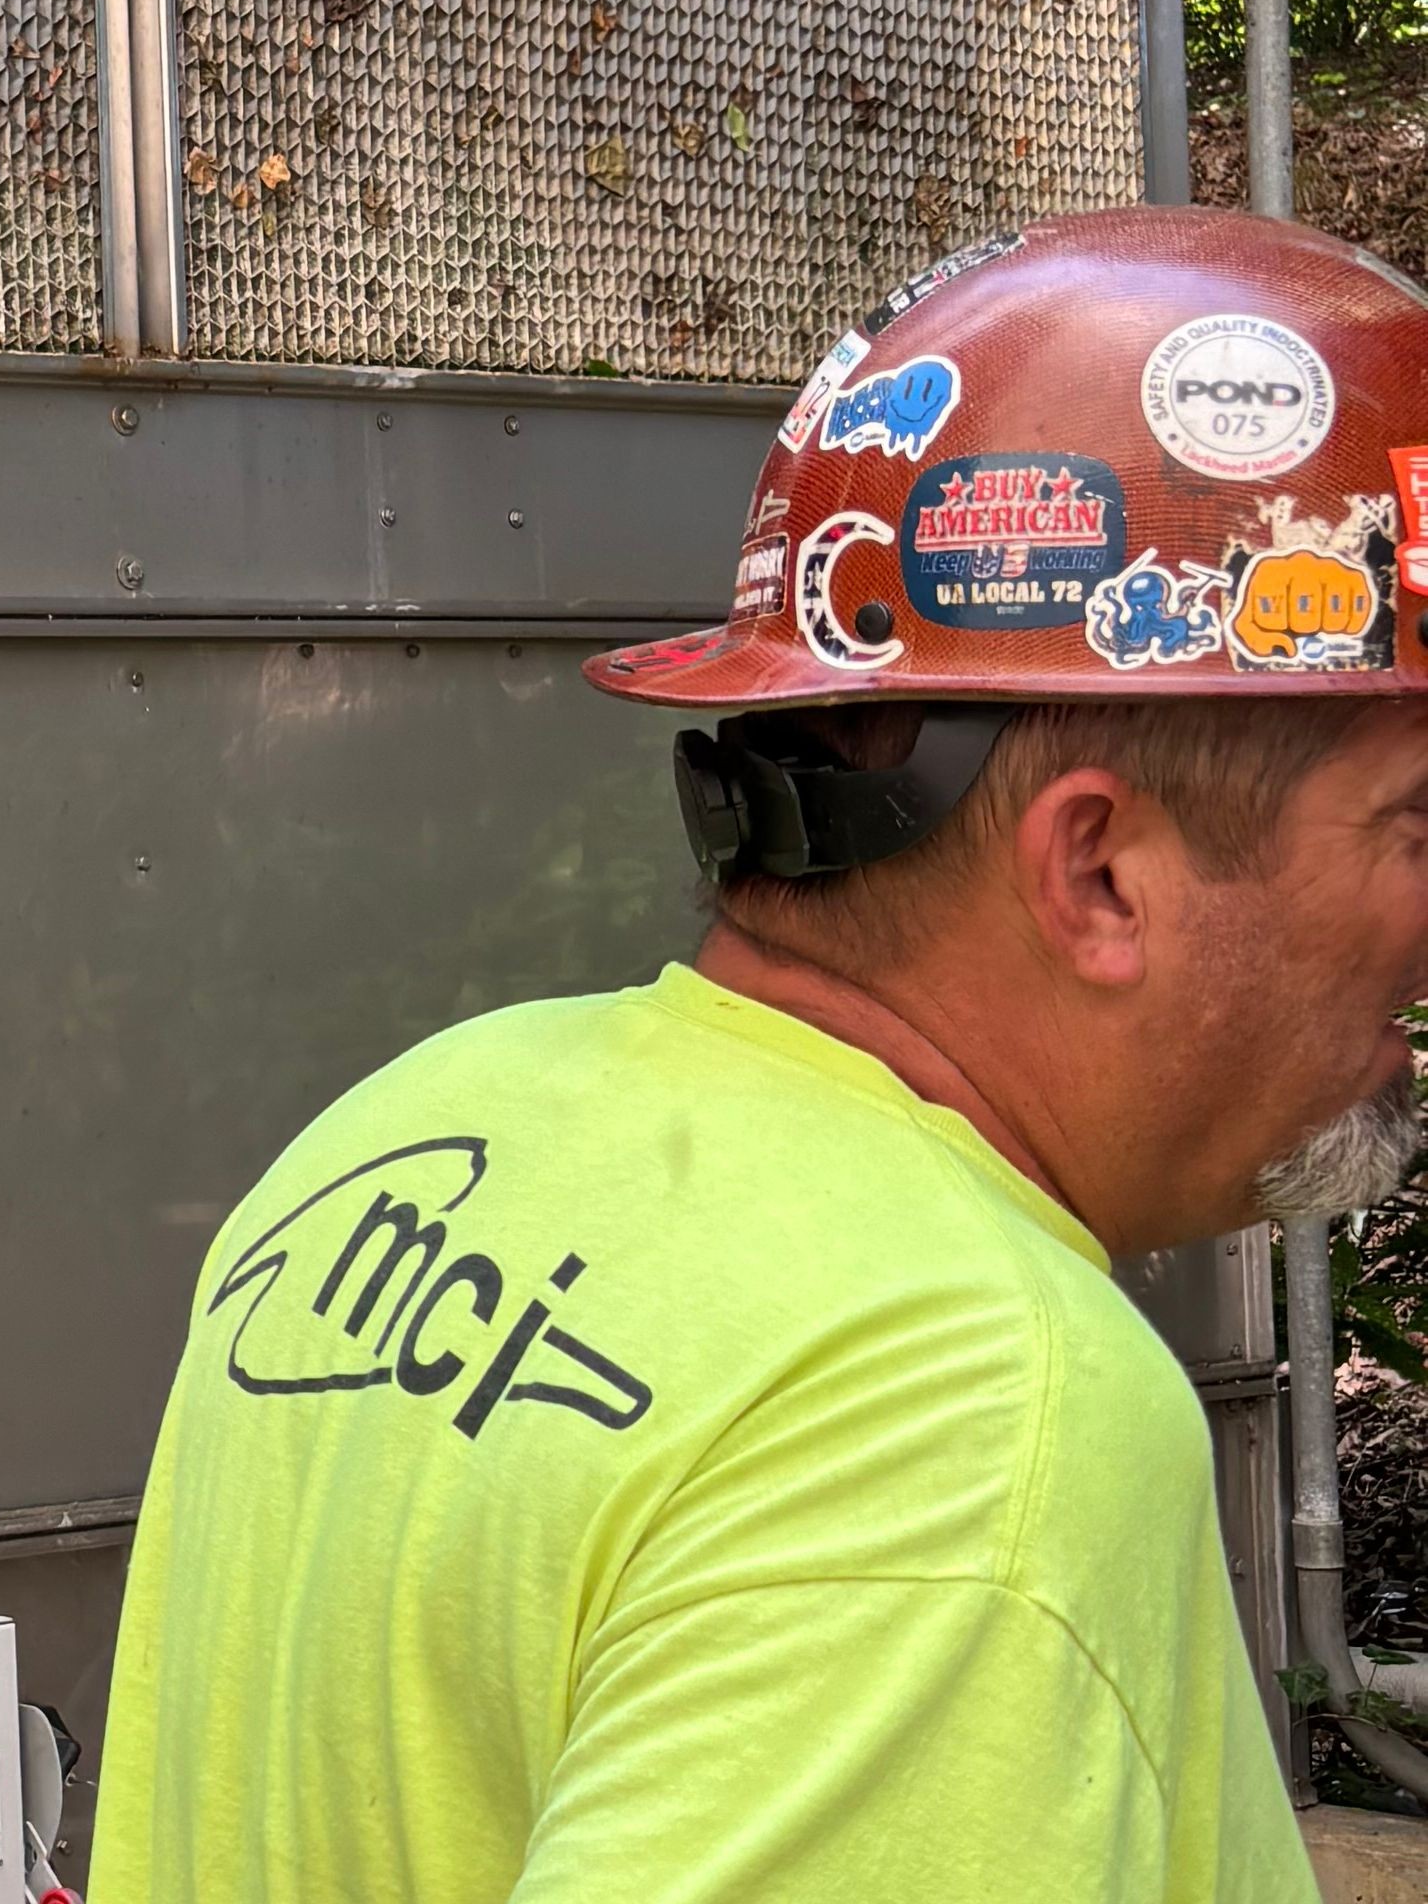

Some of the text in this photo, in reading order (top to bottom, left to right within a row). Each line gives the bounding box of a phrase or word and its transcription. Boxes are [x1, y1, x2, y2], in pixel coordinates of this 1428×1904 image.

[1148, 320, 1329, 428] SAFETY AND QUALITY INDOCTRINATED
[1175, 380, 1302, 407] POND
[1212, 413, 1265, 437] 075
[1181, 446, 1249, 474] Lockheed
[973, 467, 1046, 501] BUY
[917, 500, 1105, 537] AMERICAN
[920, 551, 972, 576] Keep
[1030, 547, 1107, 573] Working
[936, 581, 1082, 605] UA LOCAL 72
